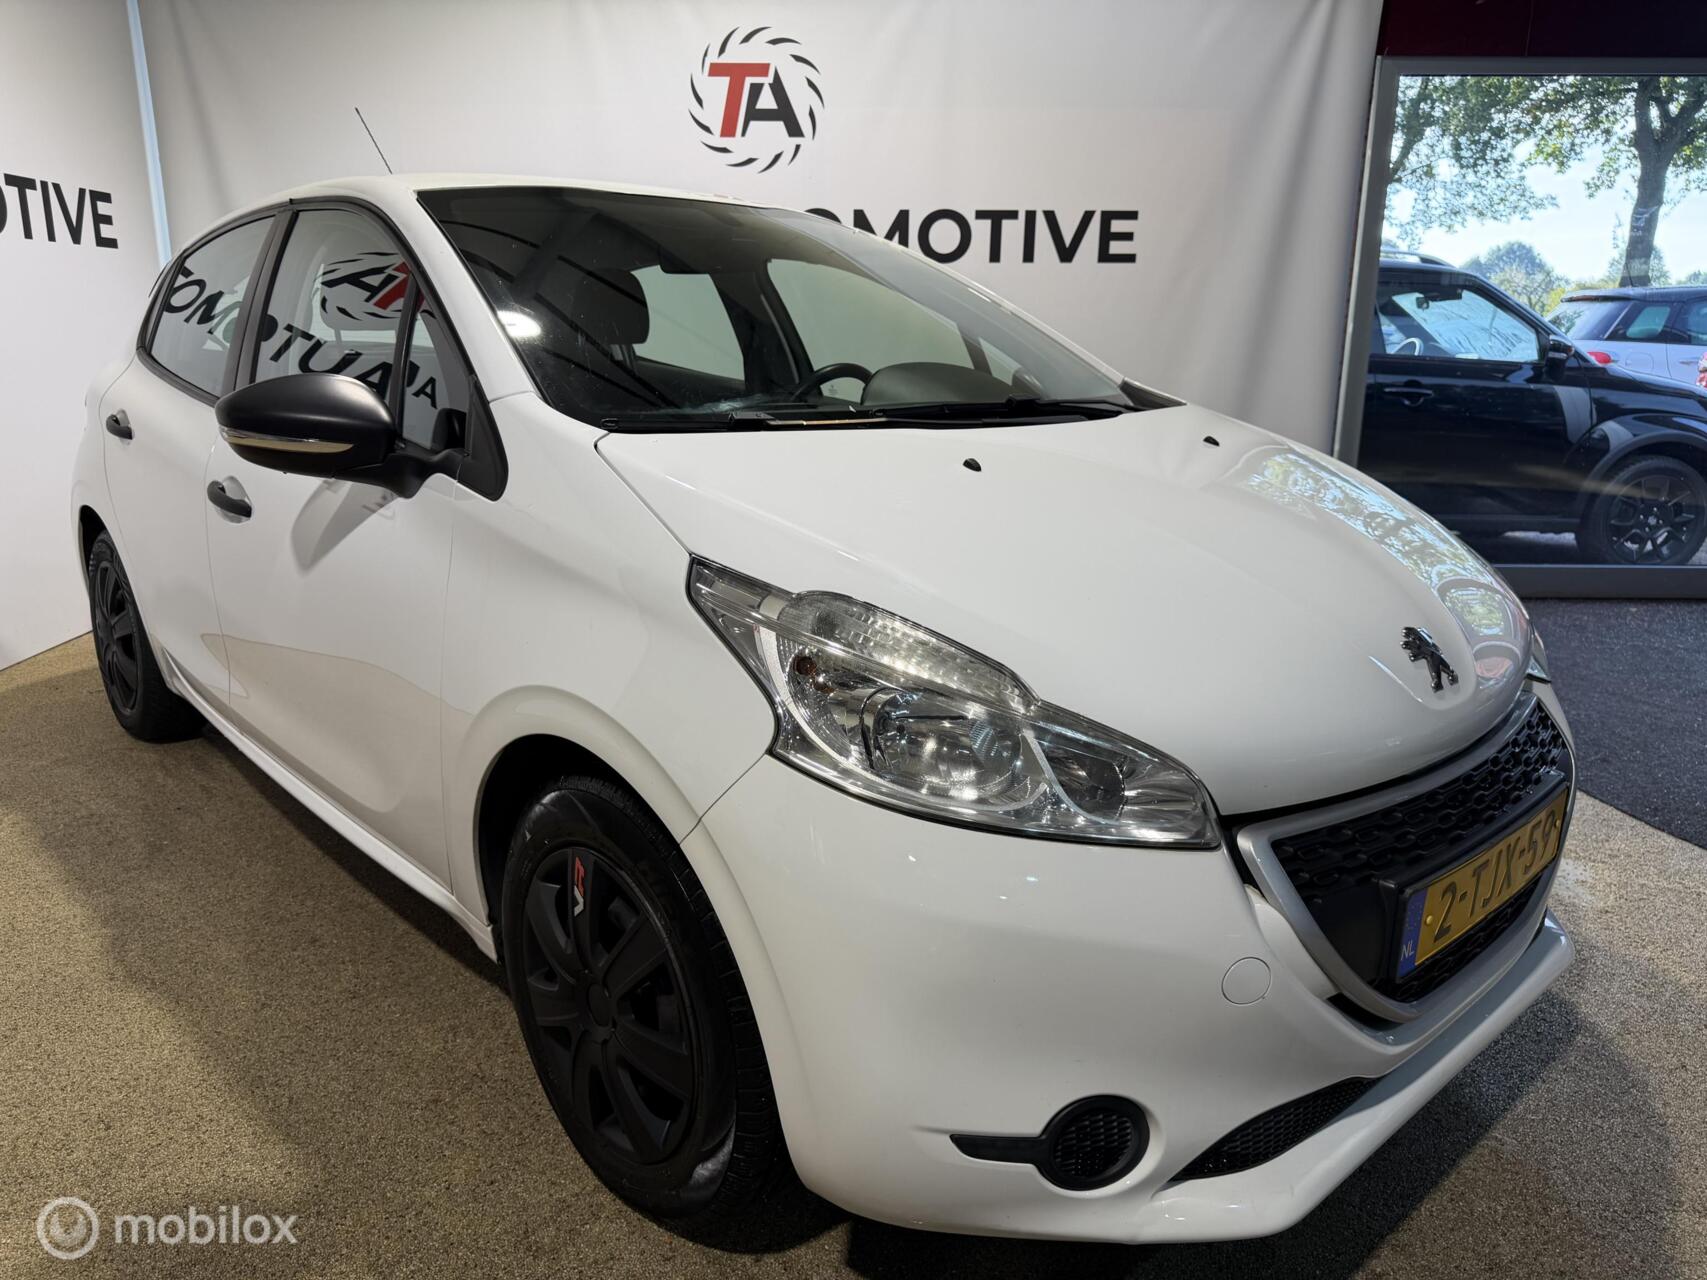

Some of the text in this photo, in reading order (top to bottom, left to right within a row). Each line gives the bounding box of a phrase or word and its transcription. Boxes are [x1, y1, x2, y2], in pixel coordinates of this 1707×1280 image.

[707, 62, 806, 138] TA
[0, 172, 119, 249] TIVE
[803, 207, 1139, 264] MOTIVE
[1433, 809, 1558, 943] 2-TJX-59
[1401, 940, 1415, 961] NL
